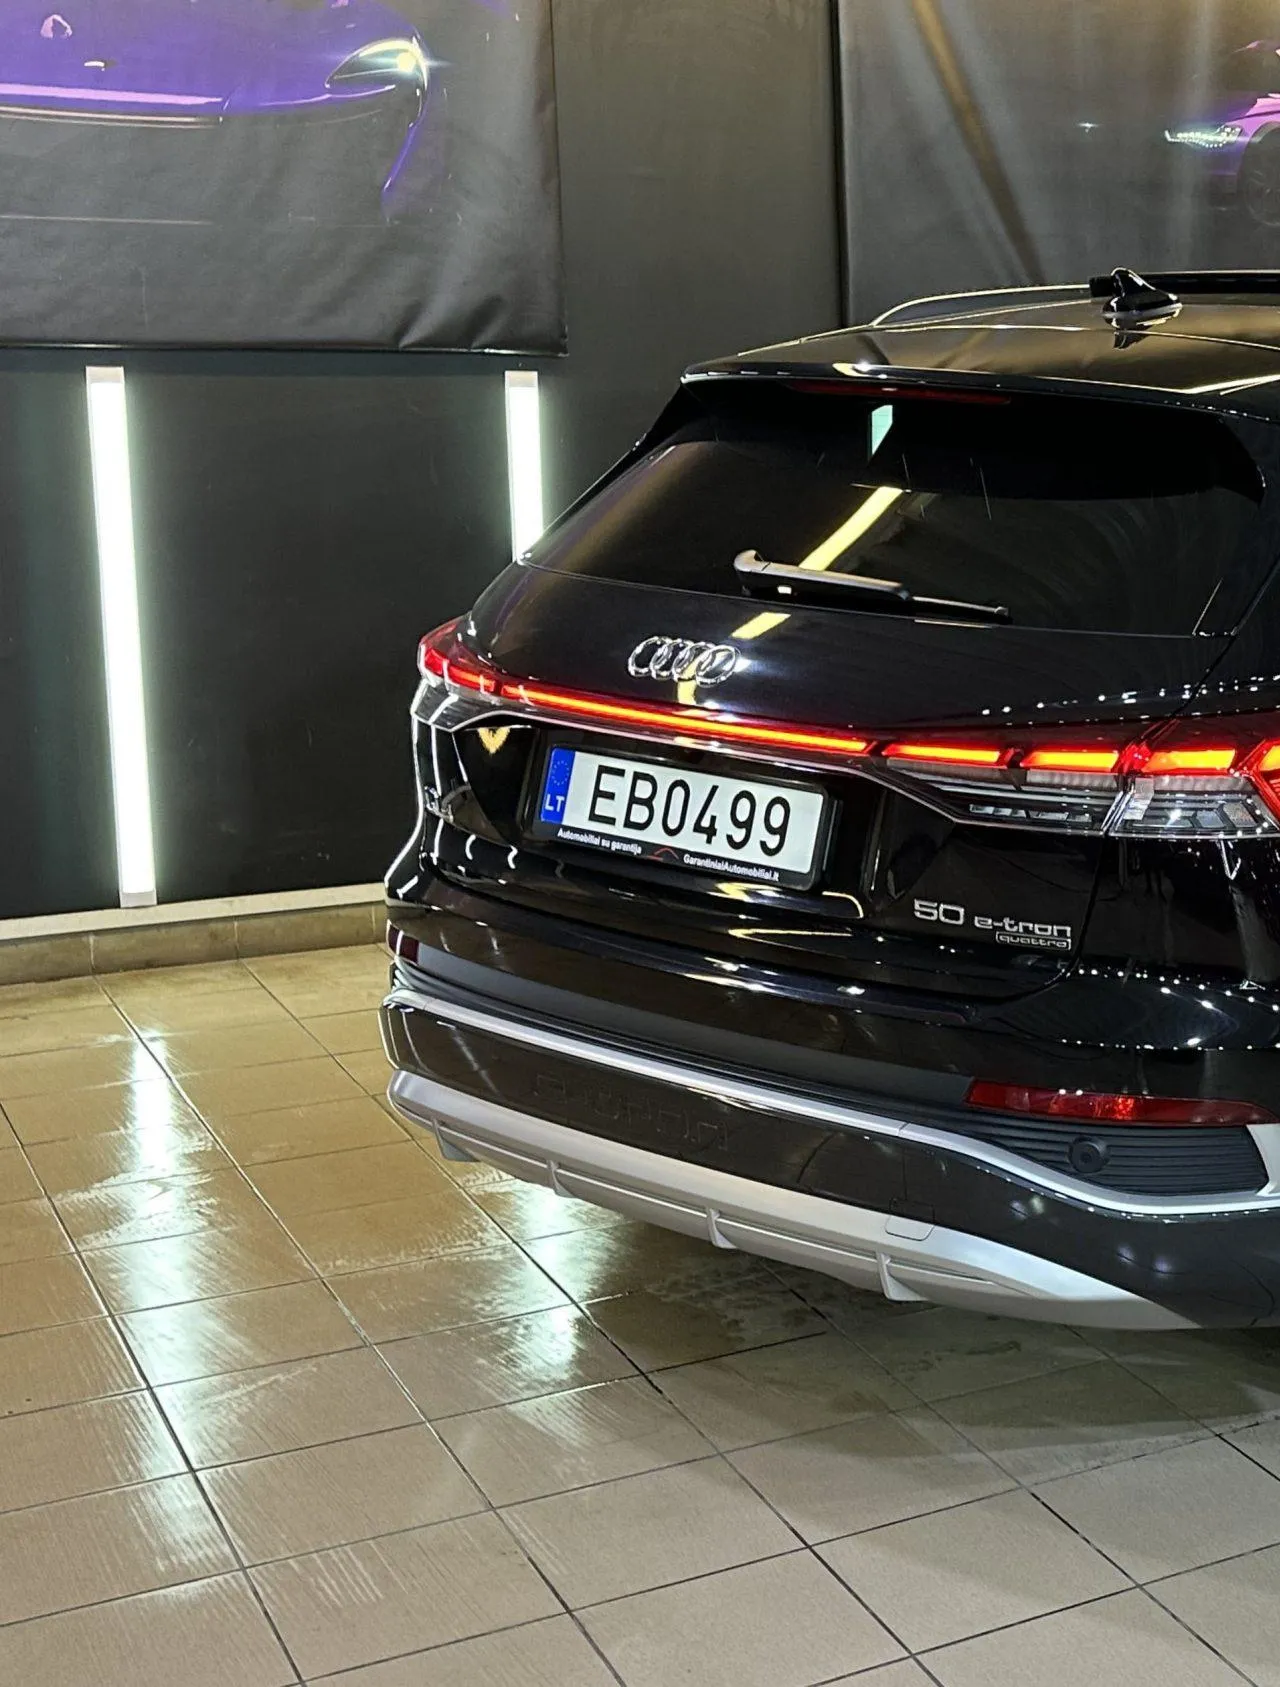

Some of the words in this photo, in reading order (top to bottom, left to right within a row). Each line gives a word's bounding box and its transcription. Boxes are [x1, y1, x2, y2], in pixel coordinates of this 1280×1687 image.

[544, 792, 566, 813] LT
[588, 764, 791, 857] EB0499
[557, 828, 600, 847] Automobiliai
[601, 839, 611, 848] su
[913, 898, 965, 926] 50
[974, 917, 1072, 938] e-tron
[998, 933, 1070, 949] quattro
